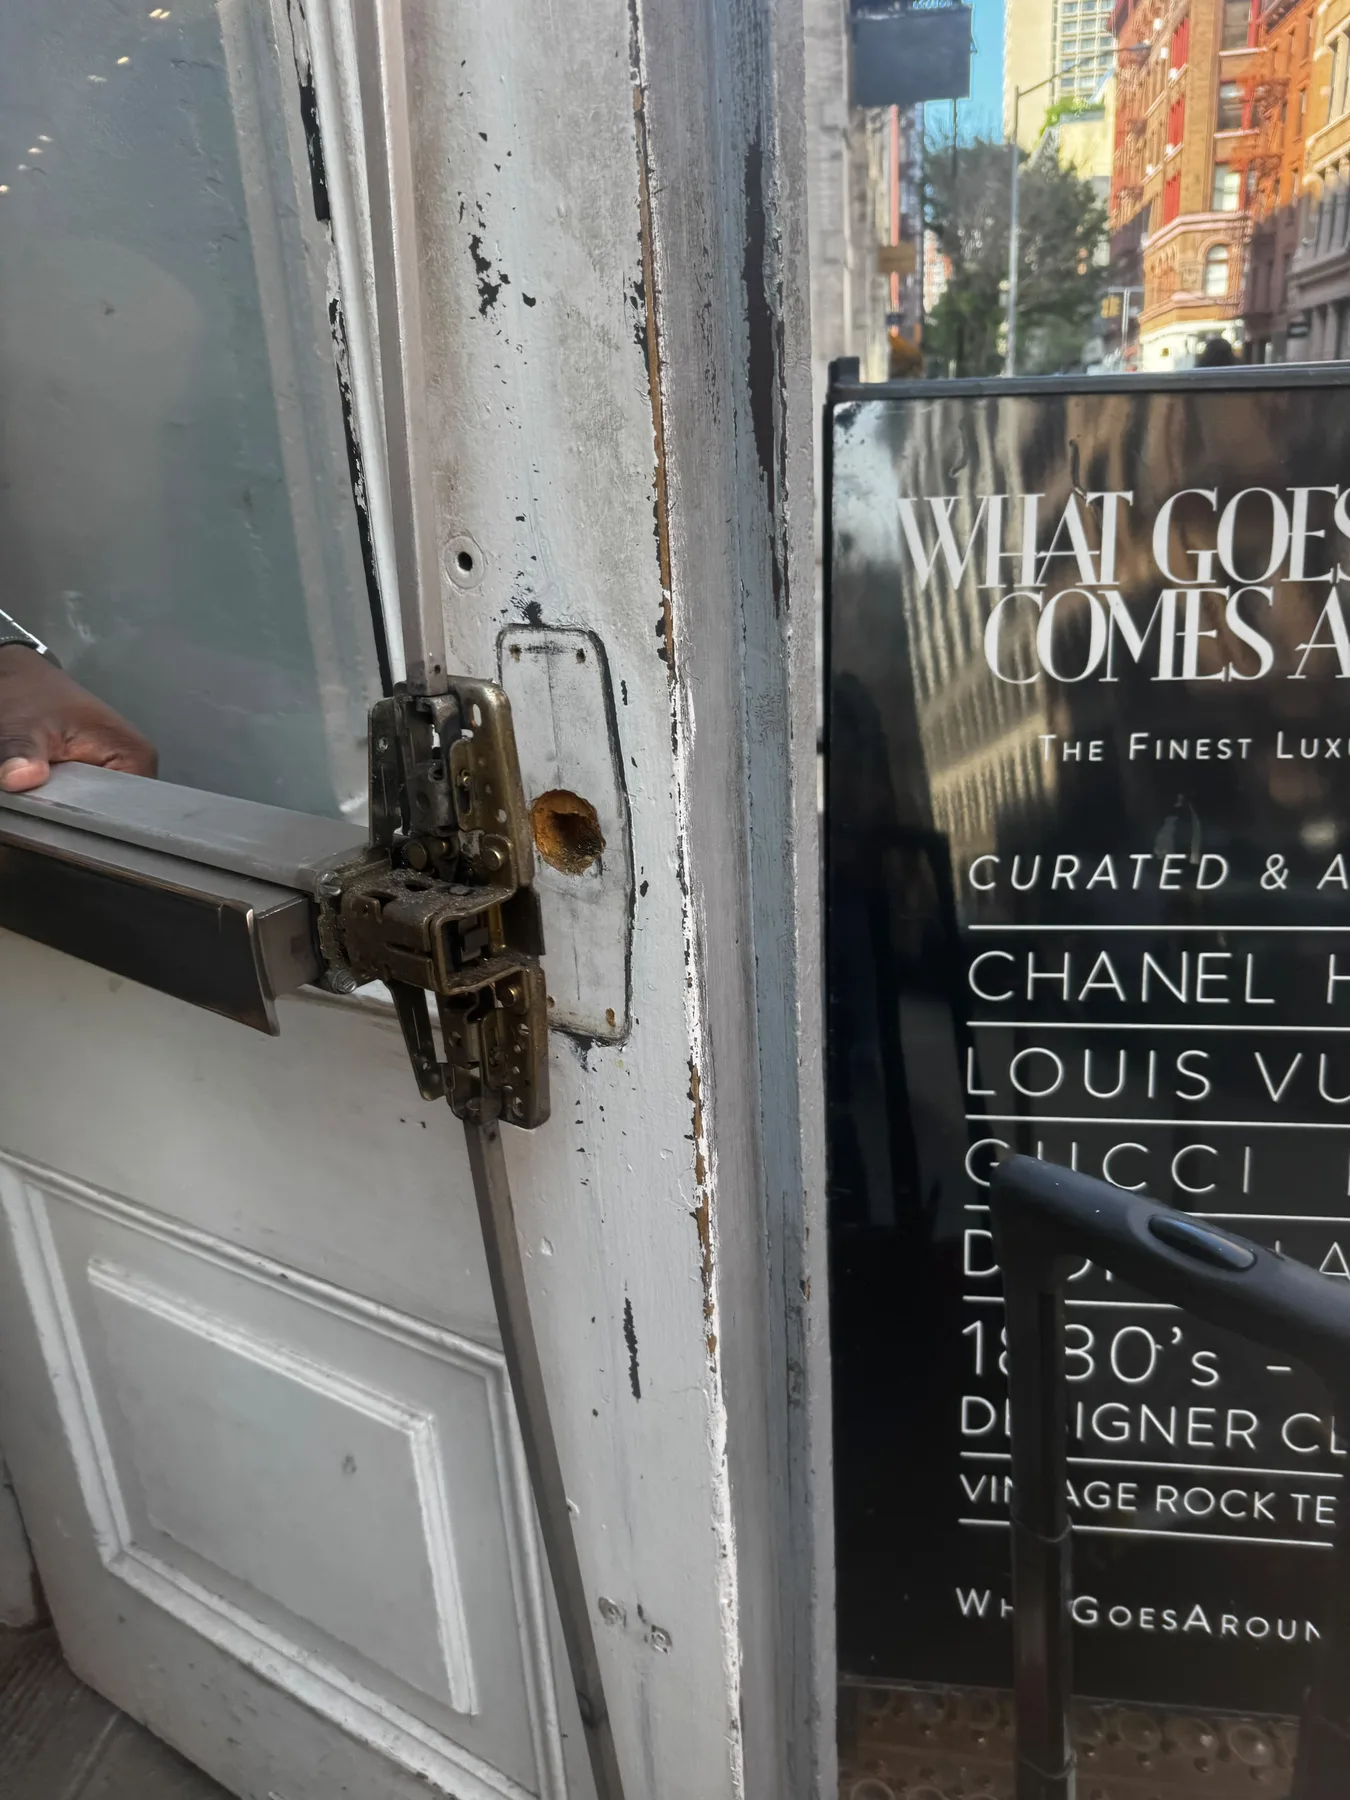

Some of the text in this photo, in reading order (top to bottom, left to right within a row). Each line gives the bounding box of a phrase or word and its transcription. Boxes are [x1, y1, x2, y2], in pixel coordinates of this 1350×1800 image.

[898, 489, 1134, 590] WHAT
[984, 586, 1275, 684] COMES
[1276, 731, 1350, 759] LUX
[968, 853, 1350, 891] CURATED & A
[968, 950, 1275, 1004] CHANEL
[966, 1046, 1212, 1101] LOUIS
[961, 1395, 1259, 1450] DIGNER
[1155, 1484, 1276, 1521] ROCK
[1290, 1492, 1337, 1525] TE
